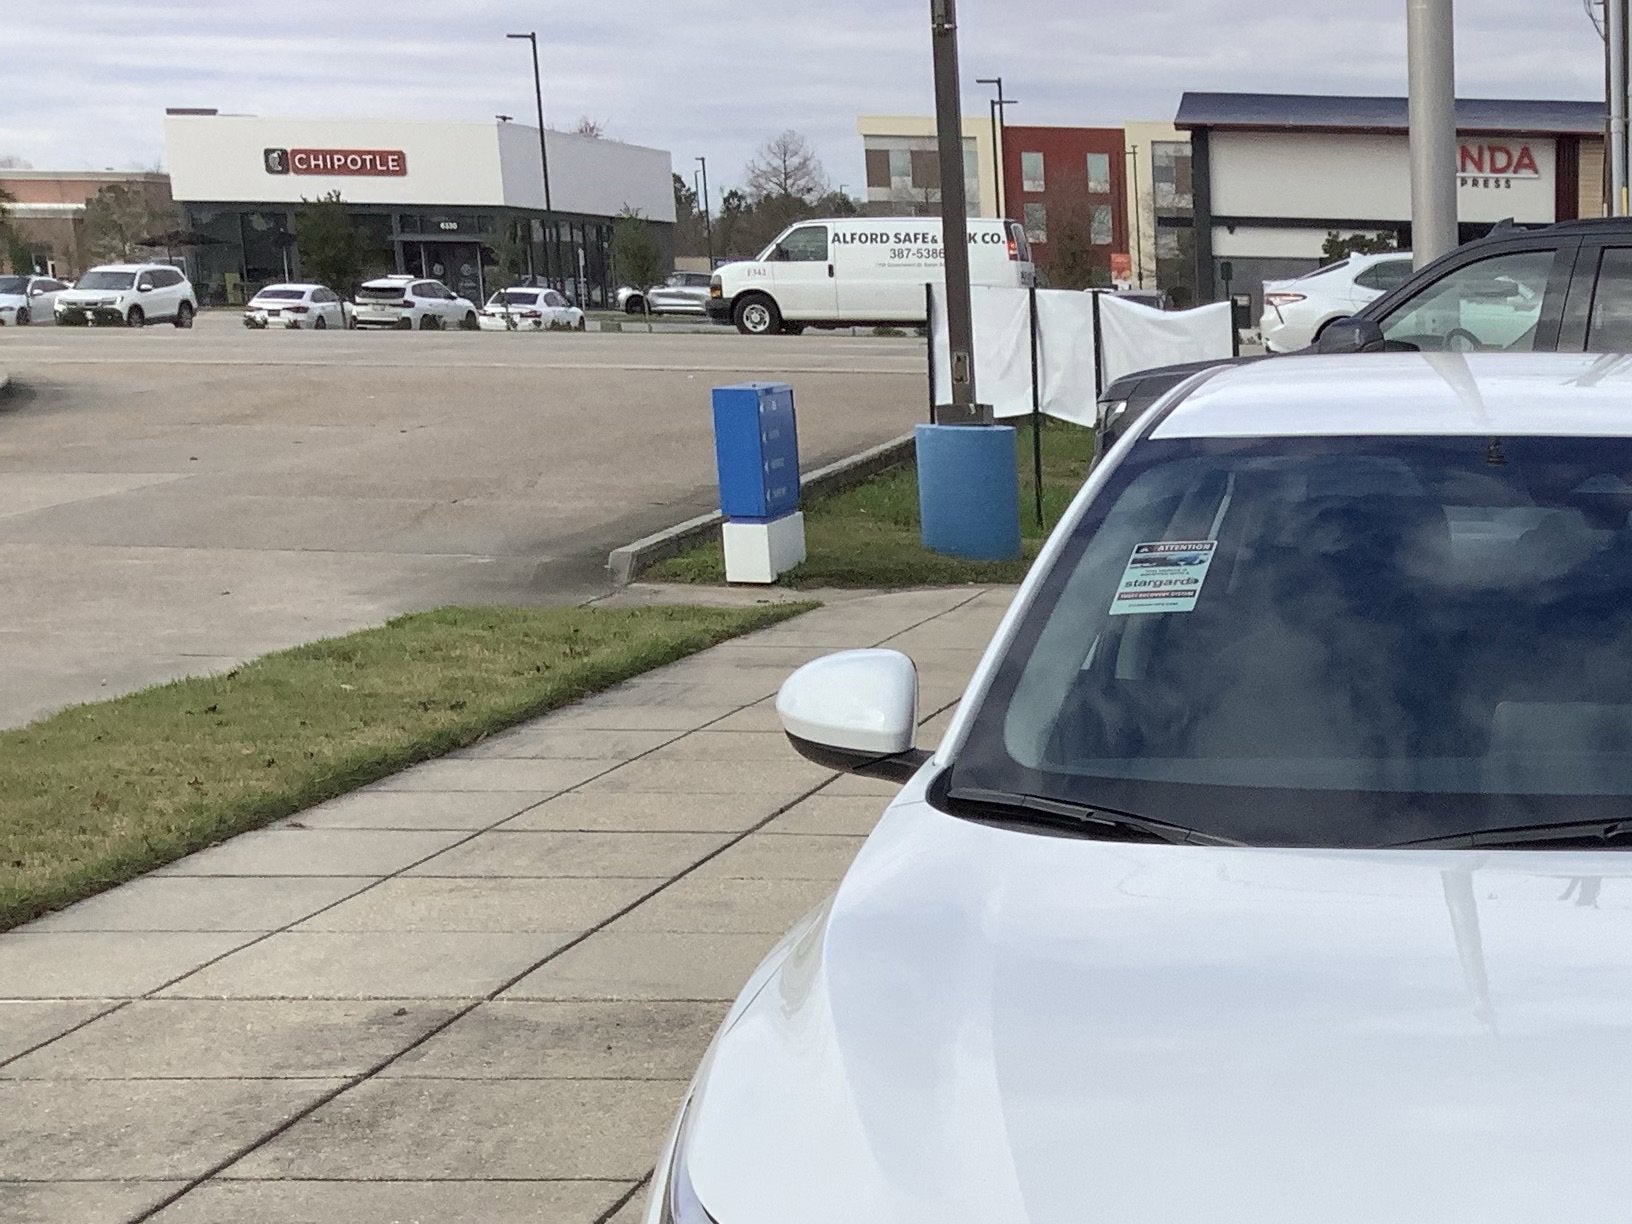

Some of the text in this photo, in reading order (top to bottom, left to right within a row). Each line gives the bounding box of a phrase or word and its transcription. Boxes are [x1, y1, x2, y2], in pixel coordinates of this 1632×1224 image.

[294, 154, 400, 170] CHIPOTLE
[1460, 144, 1538, 174] NDA
[1460, 177, 1511, 188] PRESS
[831, 232, 890, 245] ALFORD
[981, 232, 1006, 245] CO.
[889, 248, 945, 259] 387-5386
[1157, 543, 1211, 552] ATTENTION
